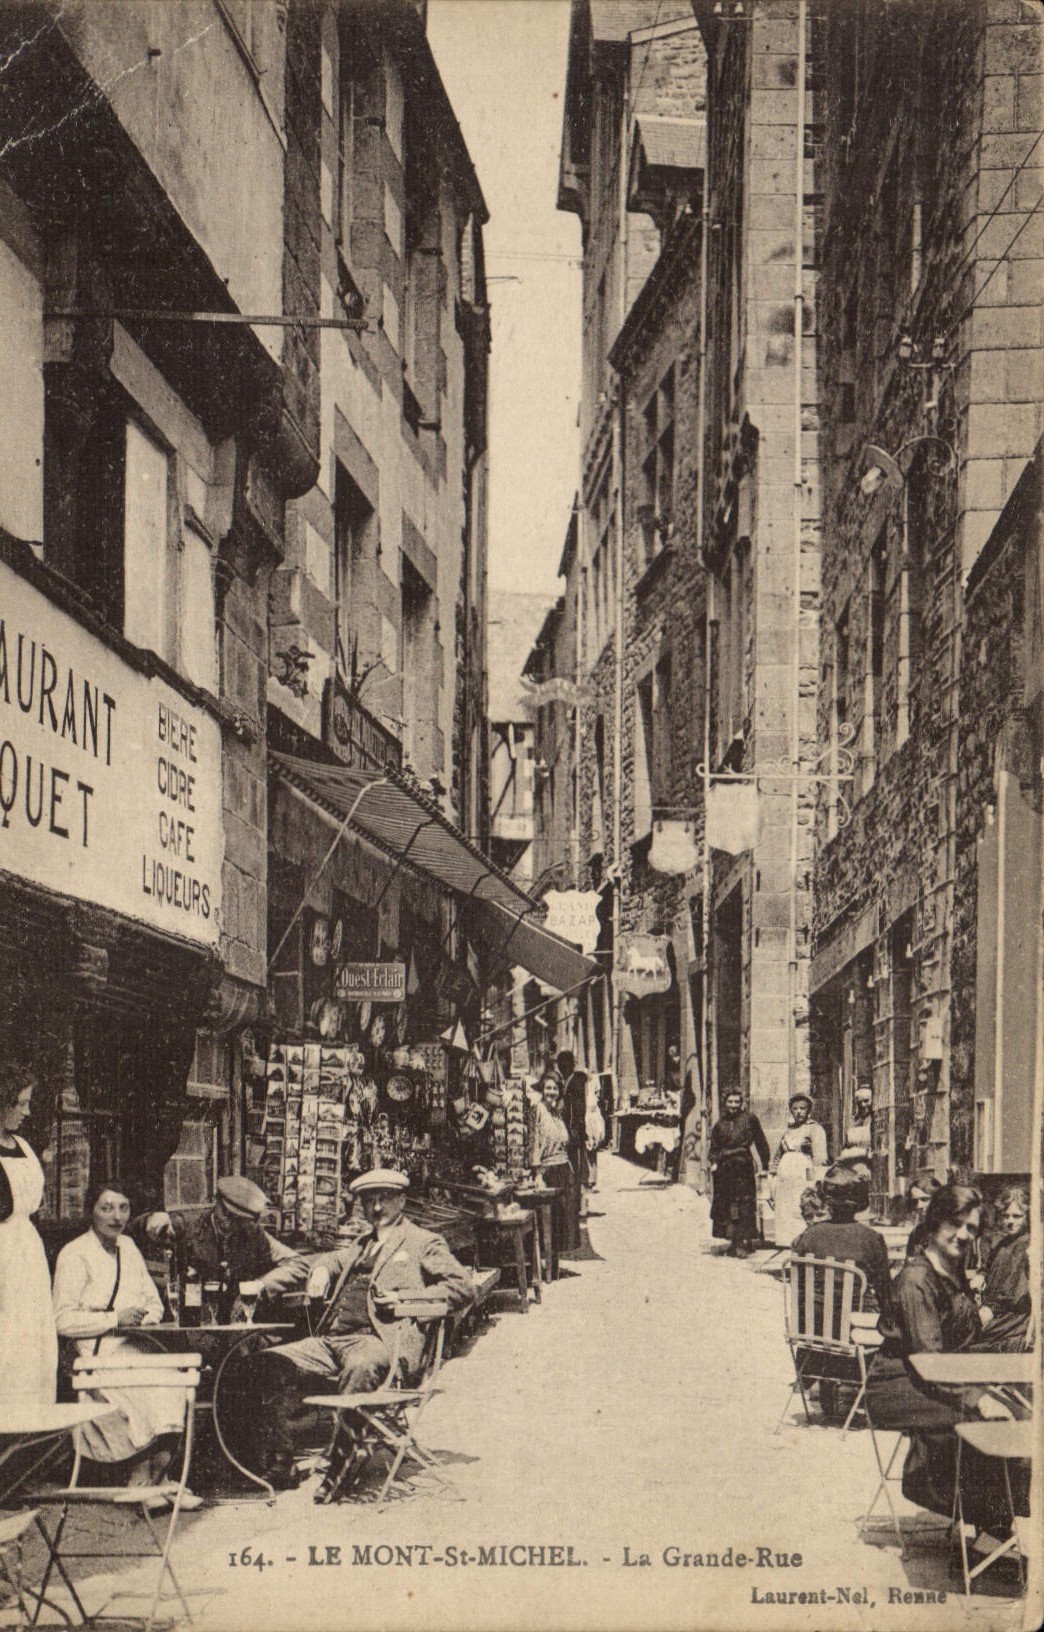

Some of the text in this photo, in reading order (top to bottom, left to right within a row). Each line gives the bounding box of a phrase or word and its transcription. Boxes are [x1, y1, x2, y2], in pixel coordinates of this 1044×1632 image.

[159, 702, 197, 763] BIERE
[0, 740, 94, 848] QUET
[158, 757, 196, 812] CIDRE
[159, 811, 196, 863] CAFE
[142, 854, 211, 919] LIQUEURS
